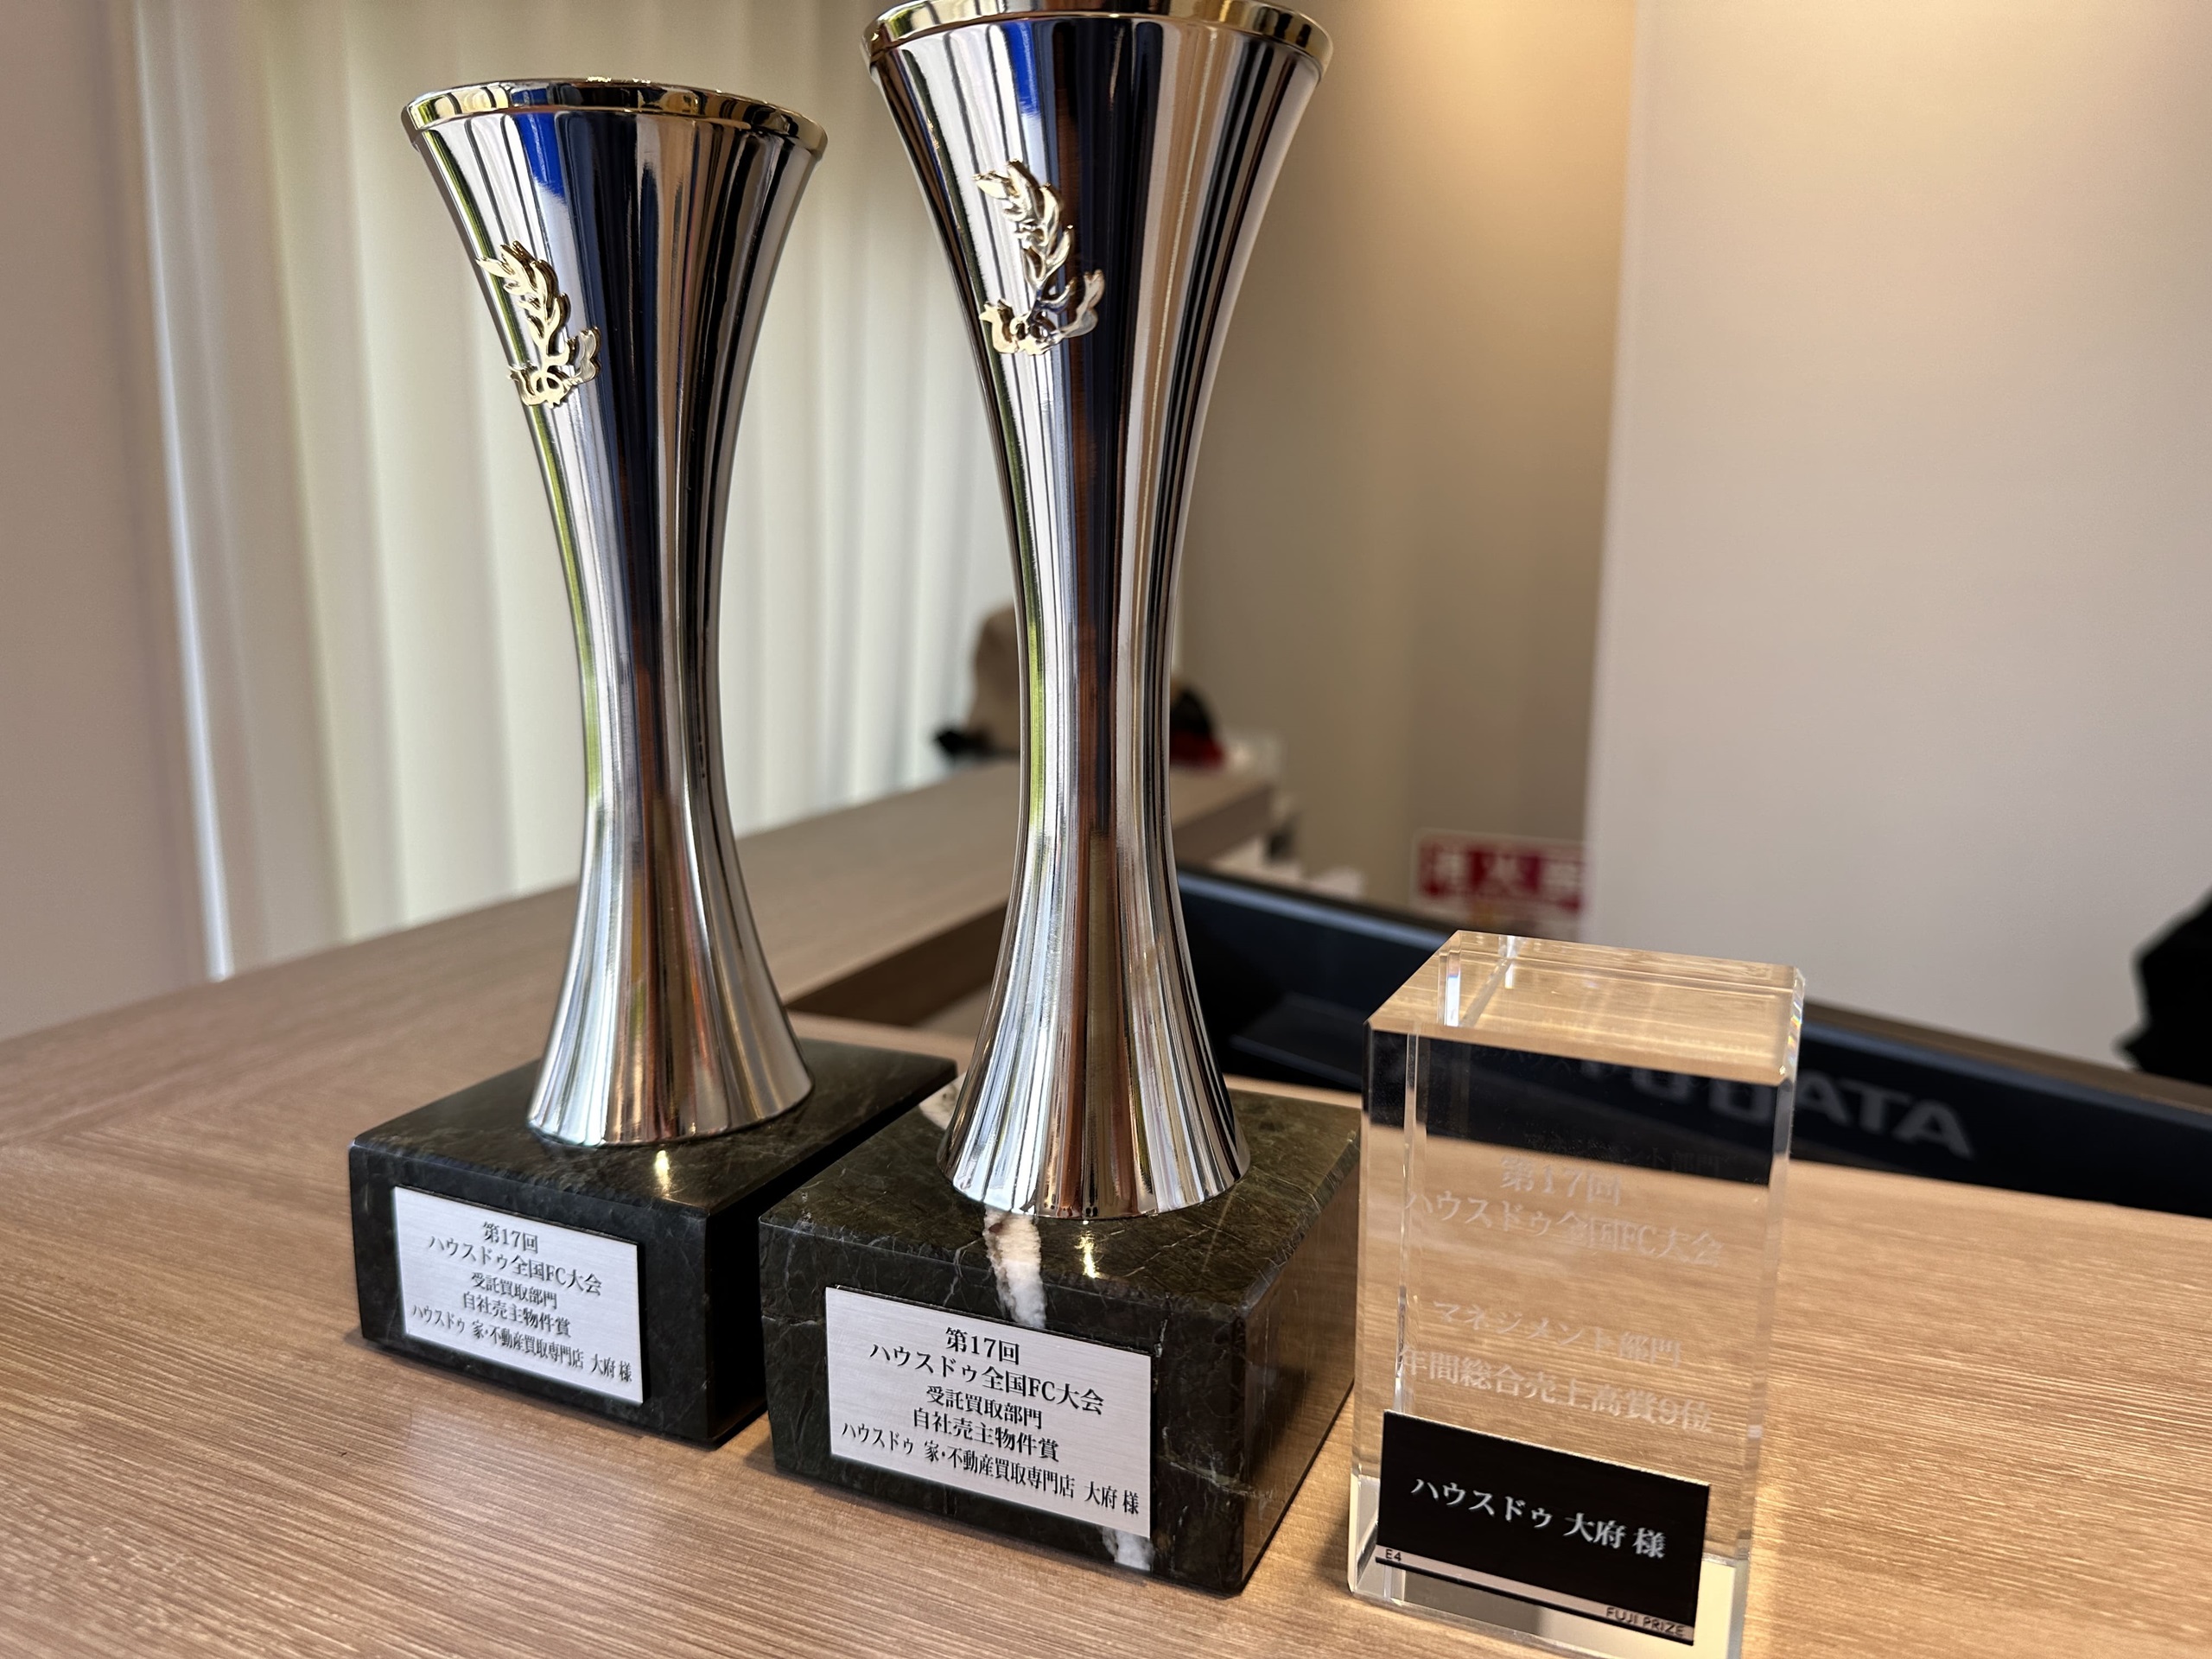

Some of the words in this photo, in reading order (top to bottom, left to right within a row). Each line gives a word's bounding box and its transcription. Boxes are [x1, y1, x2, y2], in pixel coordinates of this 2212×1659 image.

[1500, 1156, 1622, 1206] 第17回
[483, 1221, 539, 1254] 第17回
[1404, 1191, 1724, 1268] ハウスドゥ全国FC大会
[429, 1236, 603, 1296] ハウスドゥ全国FC大会
[471, 1272, 558, 1310] 受託買取部門
[463, 1292, 572, 1338] 自社売主物件賞
[1433, 1301, 1682, 1368] マネジメント部門
[412, 1304, 467, 1334] ハウスドゥ
[591, 1357, 617, 1380] 大府
[618, 1361, 632, 1383] 様
[944, 1326, 1020, 1365] 第17回
[869, 1344, 1105, 1415] ハウスドゥ全国FC大会
[1397, 1345, 1713, 1433] 年間総合売上高賞9位
[913, 1408, 1059, 1462] 自社売主物件賞
[926, 1386, 1043, 1430] 受託買取部門
[842, 1422, 914, 1456] ハウスドゥ
[924, 1440, 1076, 1499] 家・不動産買取専門店
[1084, 1480, 1118, 1510] 大府
[1122, 1489, 1140, 1515] 様
[1410, 1478, 1552, 1529] ハウスドゥ
[1562, 1512, 1626, 1549] 大府
[1631, 1527, 1667, 1560] 様
[1385, 1548, 1403, 1562] E4
[1605, 1606, 1639, 1625] FUJI
[1643, 1617, 1685, 1637] PRIZE
